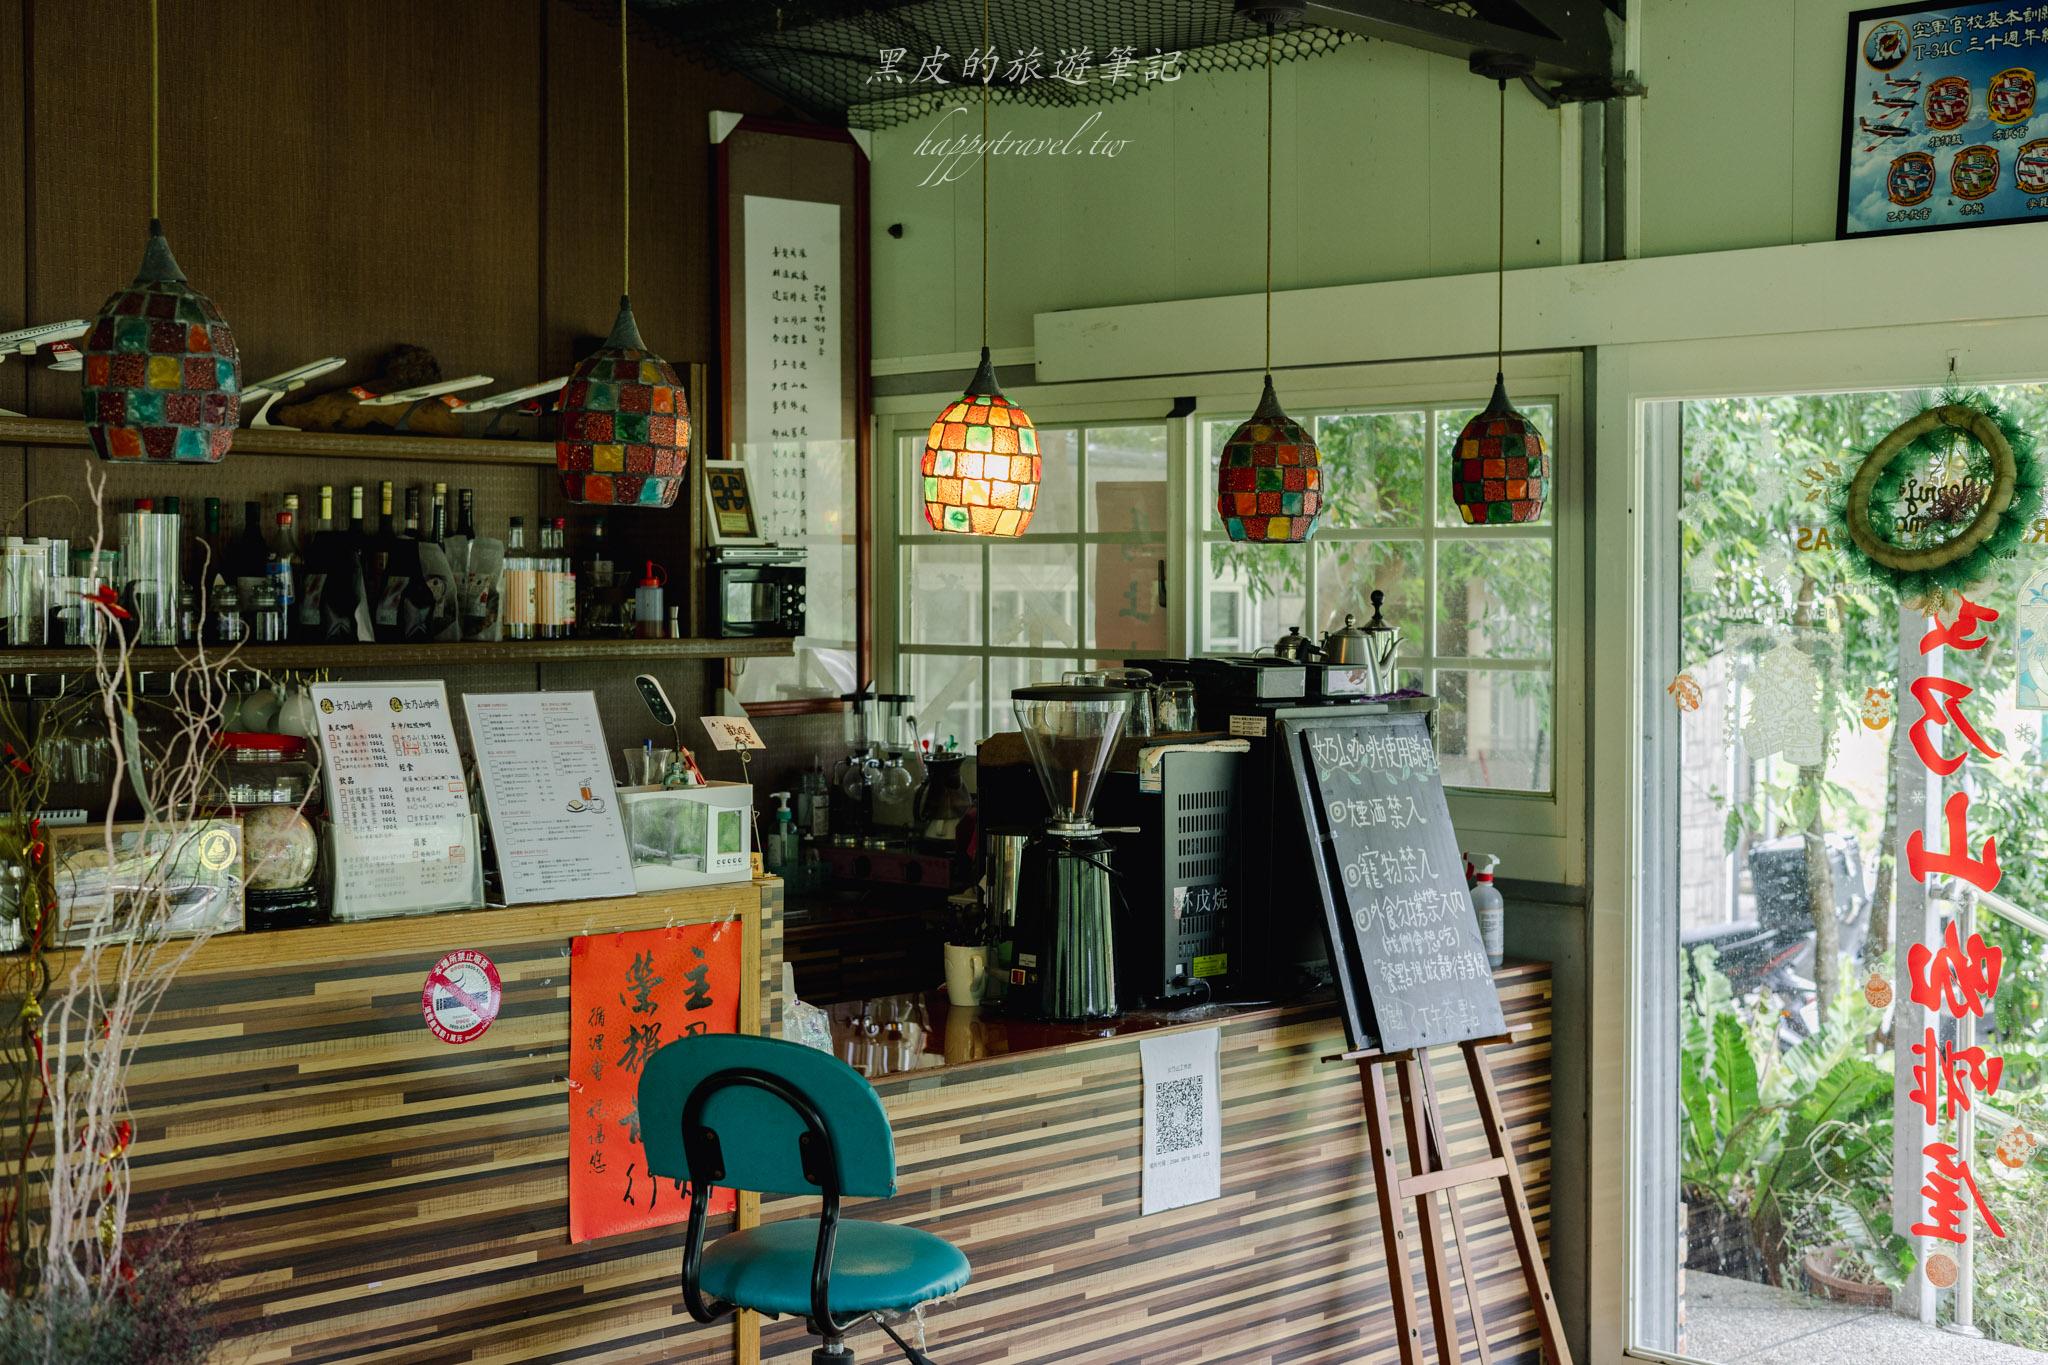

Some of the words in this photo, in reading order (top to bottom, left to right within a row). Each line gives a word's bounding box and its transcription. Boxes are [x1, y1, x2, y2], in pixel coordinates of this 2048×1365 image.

[1913, 38, 1962, 62] T-34C
[1357, 845, 1440, 889] 寵物禁入
